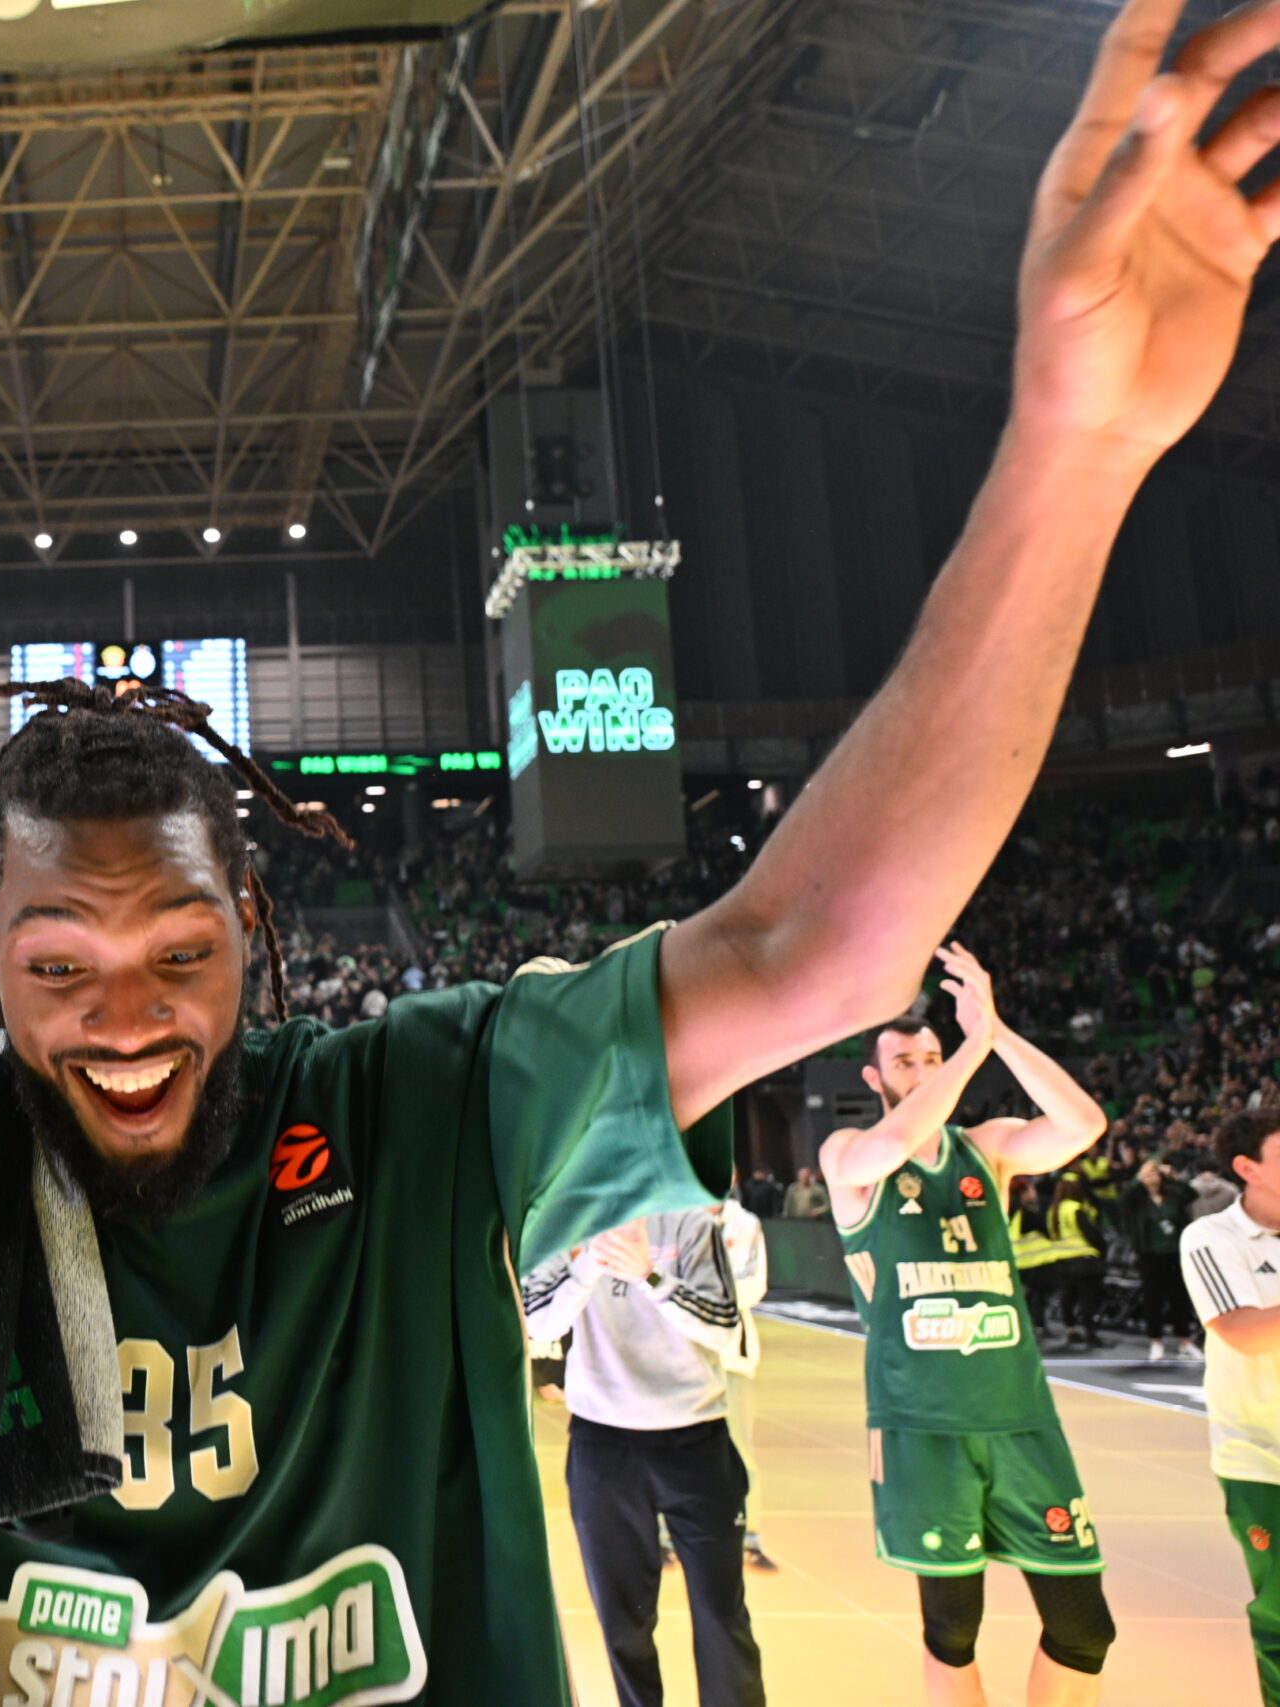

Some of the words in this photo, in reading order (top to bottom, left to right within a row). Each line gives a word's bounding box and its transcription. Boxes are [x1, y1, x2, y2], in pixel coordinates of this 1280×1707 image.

[556, 667, 655, 711] PAO
[538, 707, 676, 753] WINS
[111, 1324, 259, 1510] 35
[29, 1586, 122, 1636] pame
